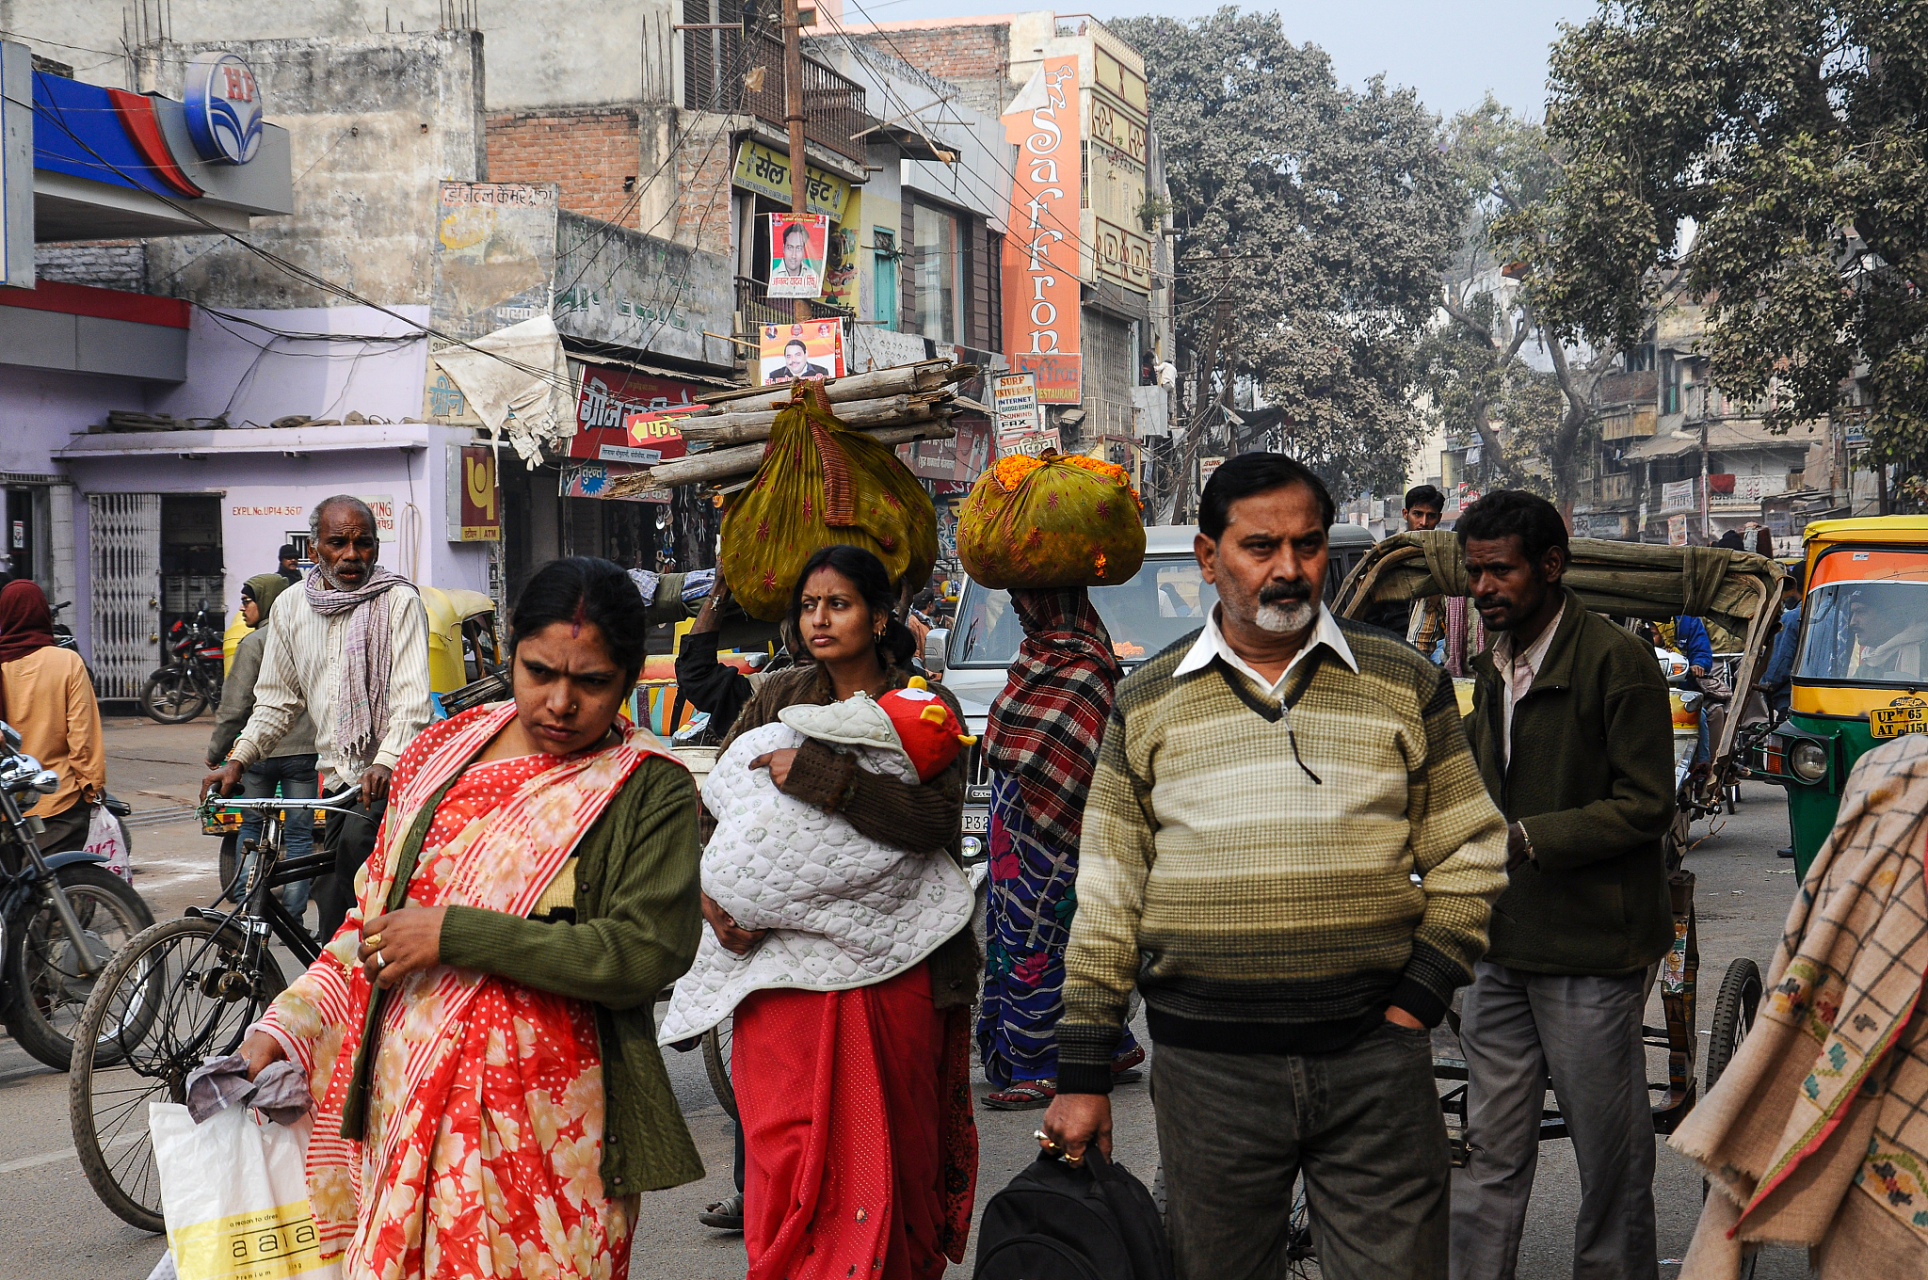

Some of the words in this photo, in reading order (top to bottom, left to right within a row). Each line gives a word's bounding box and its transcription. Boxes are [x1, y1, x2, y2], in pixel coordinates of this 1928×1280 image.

[223, 66, 255, 102] HP
[756, 152, 787, 185] सेल
[1025, 95, 1065, 354] Saffron
[1000, 376, 1025, 387] SURF
[998, 396, 1032, 405] INTERNET
[1001, 419, 1027, 428] FAX
[483, 529, 497, 538] ATM
[1877, 711, 1896, 722] UP
[1907, 709, 1922, 719] 65
[1877, 724, 1894, 735] AT
[1905, 722, 1928, 733] 1151
